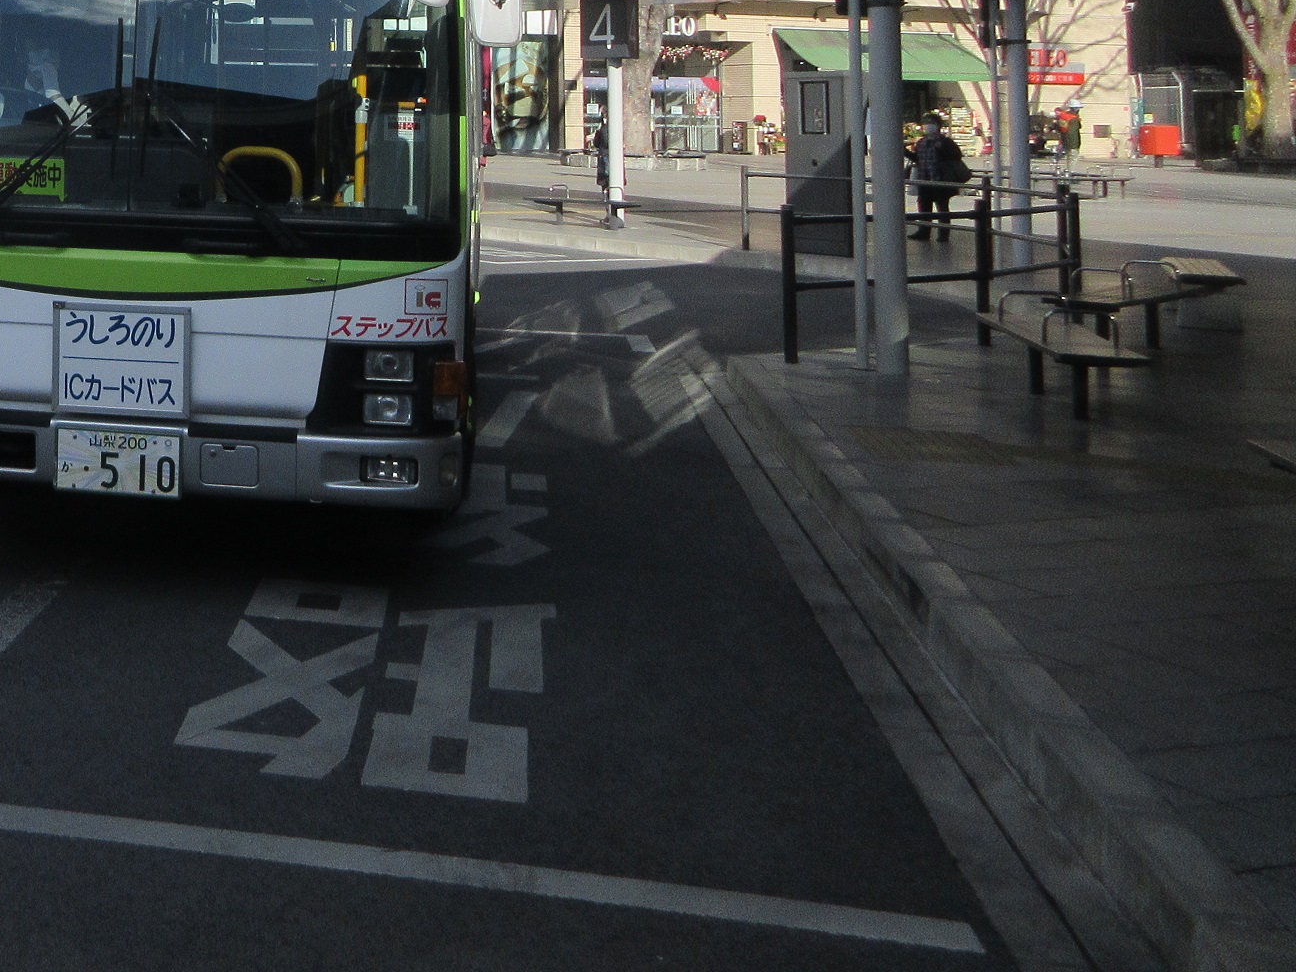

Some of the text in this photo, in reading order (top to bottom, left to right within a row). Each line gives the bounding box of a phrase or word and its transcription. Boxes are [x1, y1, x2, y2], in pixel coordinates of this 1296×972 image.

[588, 3, 615, 50] 4
[65, 311, 176, 349] うしろのり
[330, 315, 448, 339] ステップバス
[64, 372, 176, 406] ICカードバス
